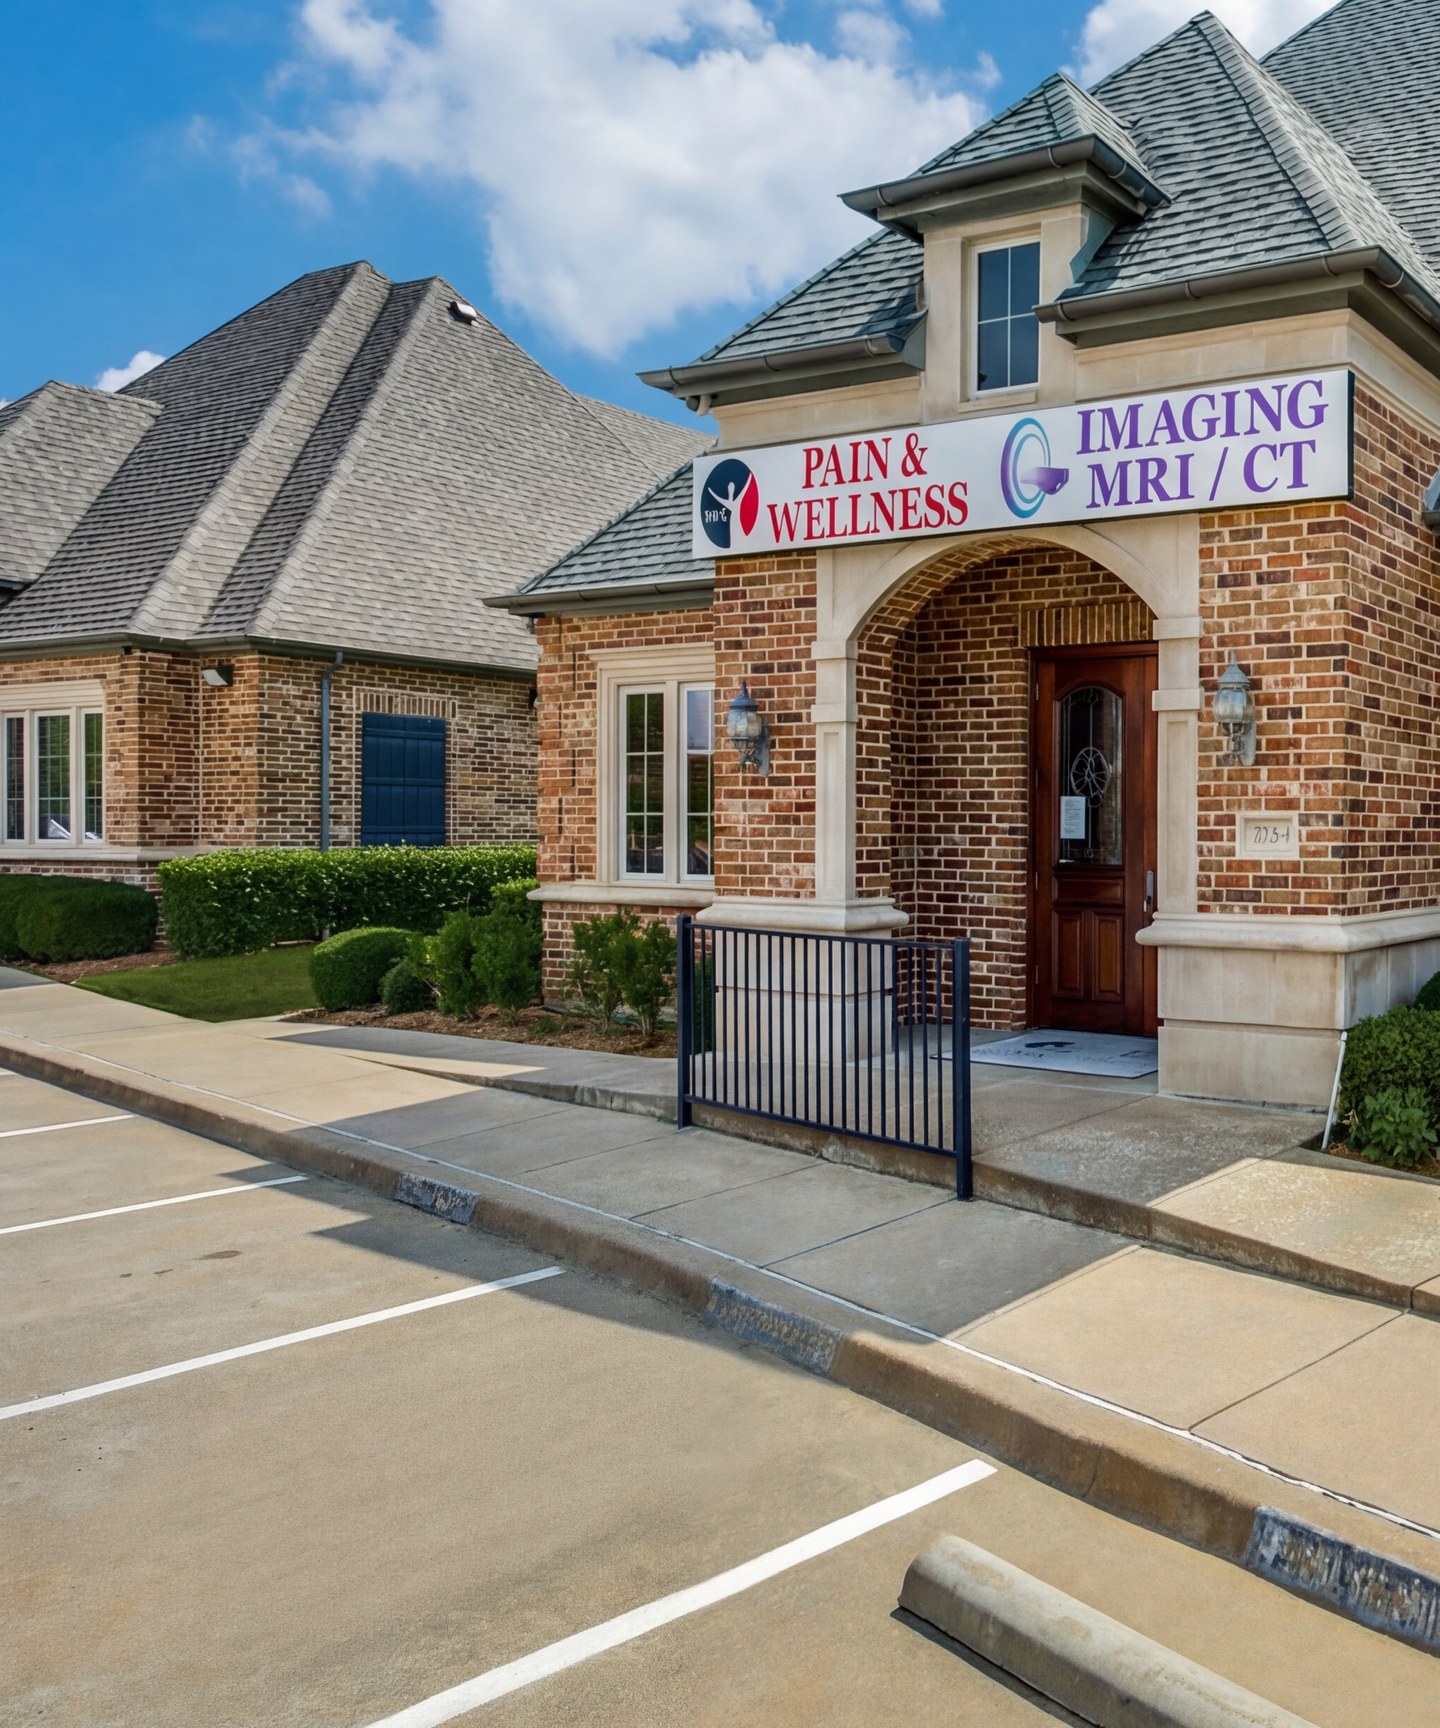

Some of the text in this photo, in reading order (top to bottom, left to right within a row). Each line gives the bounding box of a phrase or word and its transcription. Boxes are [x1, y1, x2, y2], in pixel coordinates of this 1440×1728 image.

[1076, 379, 1328, 455] IMAGING
[802, 432, 928, 489] PAIN &
[1086, 454, 1195, 509] MRI
[1243, 440, 1316, 493] CT
[766, 481, 969, 544] WELLNESS
